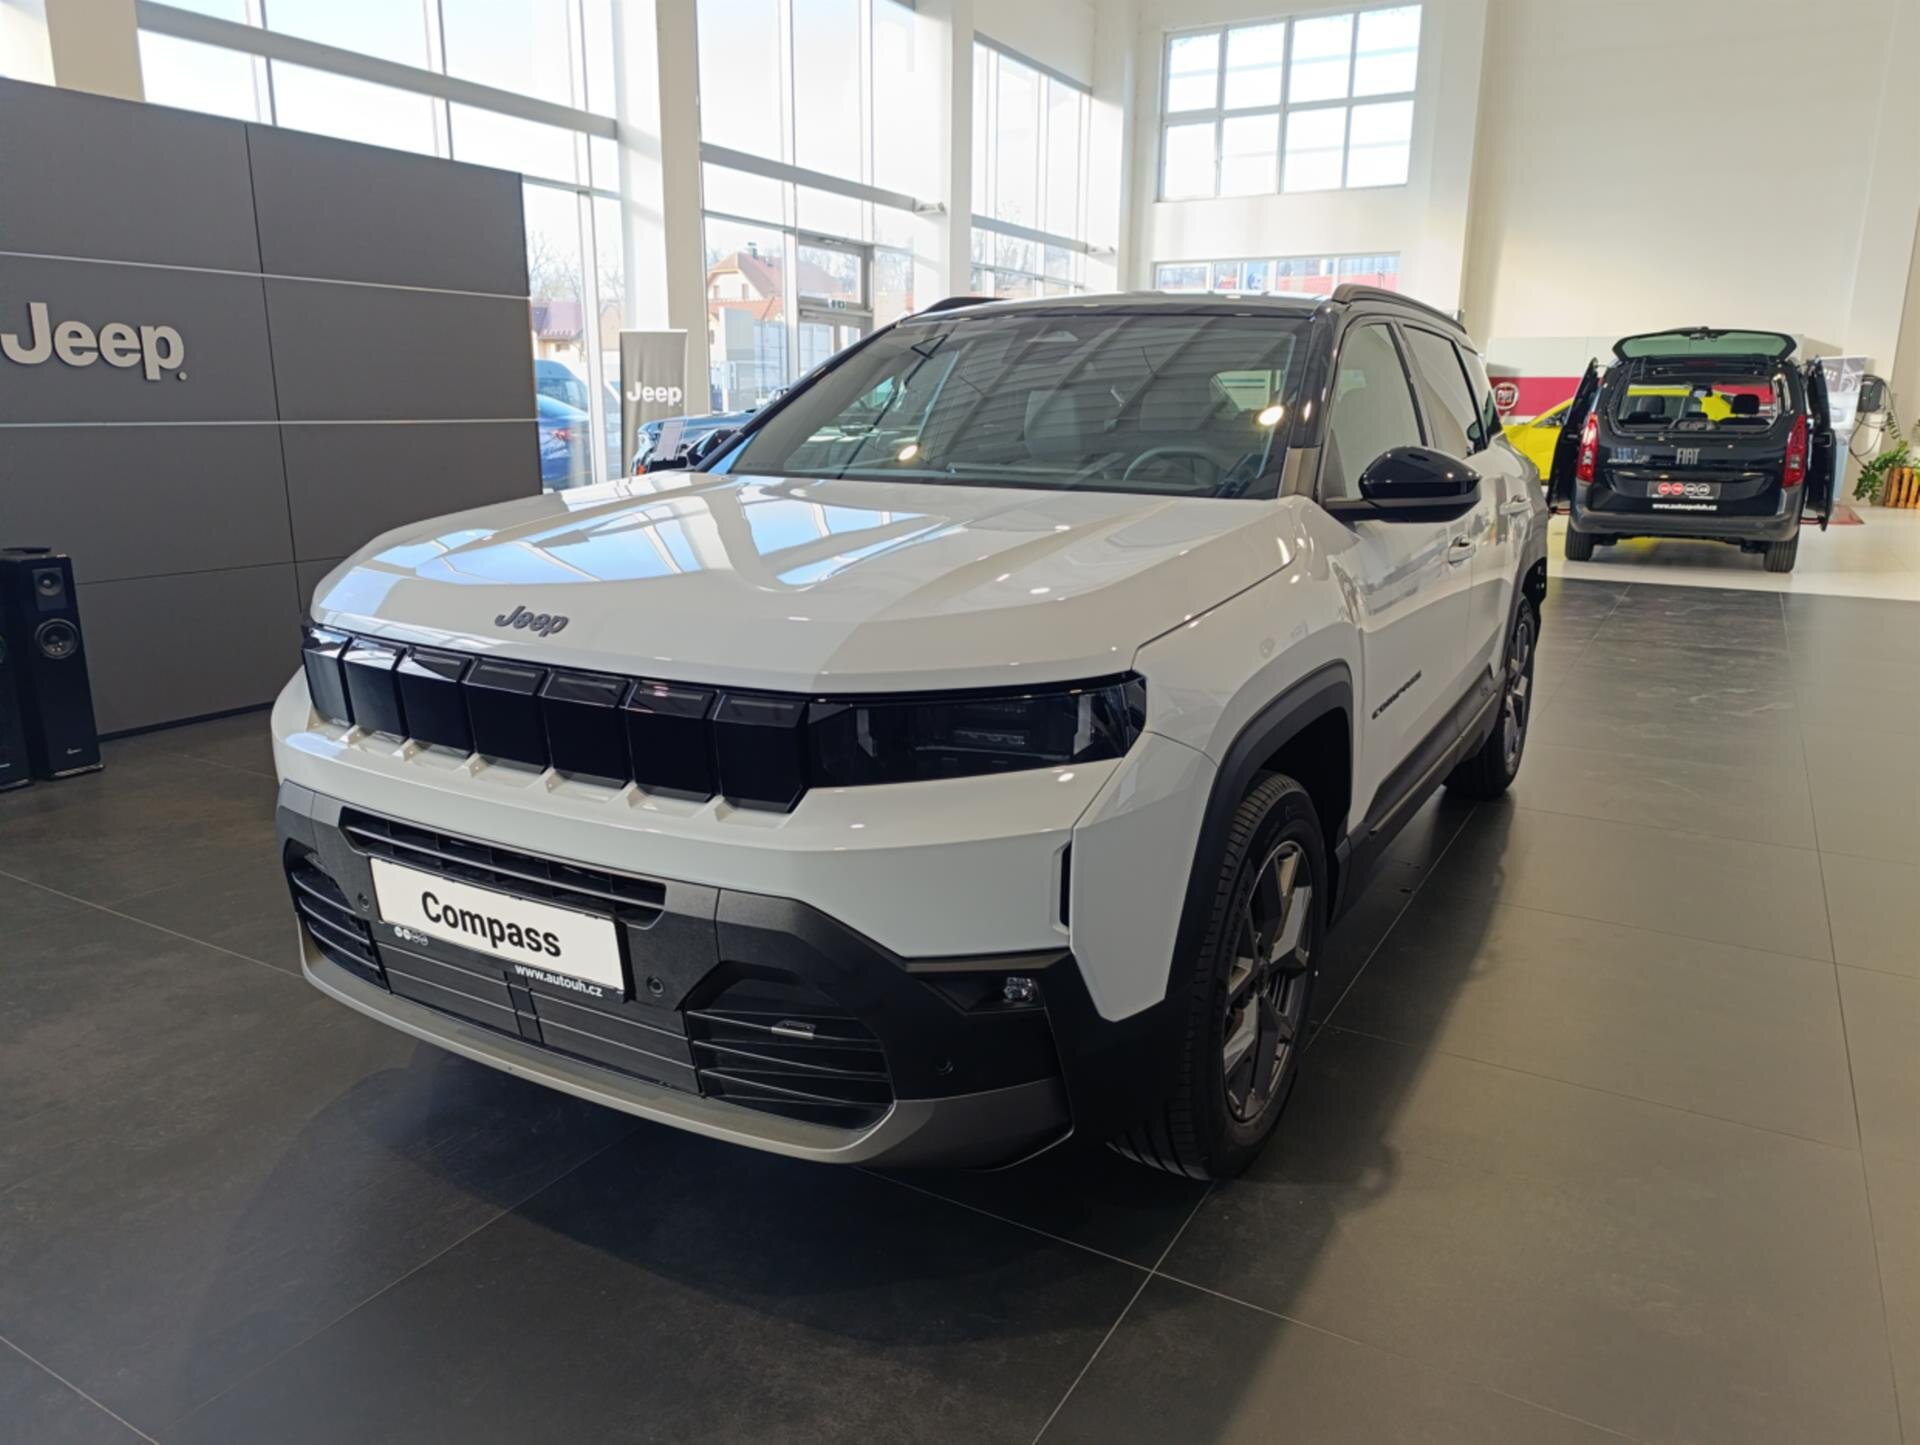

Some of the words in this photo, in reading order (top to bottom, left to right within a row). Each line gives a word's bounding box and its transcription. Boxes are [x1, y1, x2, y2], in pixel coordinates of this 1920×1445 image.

[626, 381, 683, 407] Jeep
[1676, 448, 1700, 465] FIAT
[494, 605, 569, 638] Jeep
[421, 891, 562, 958] Compass
[515, 964, 604, 998] www.autouh.cz
